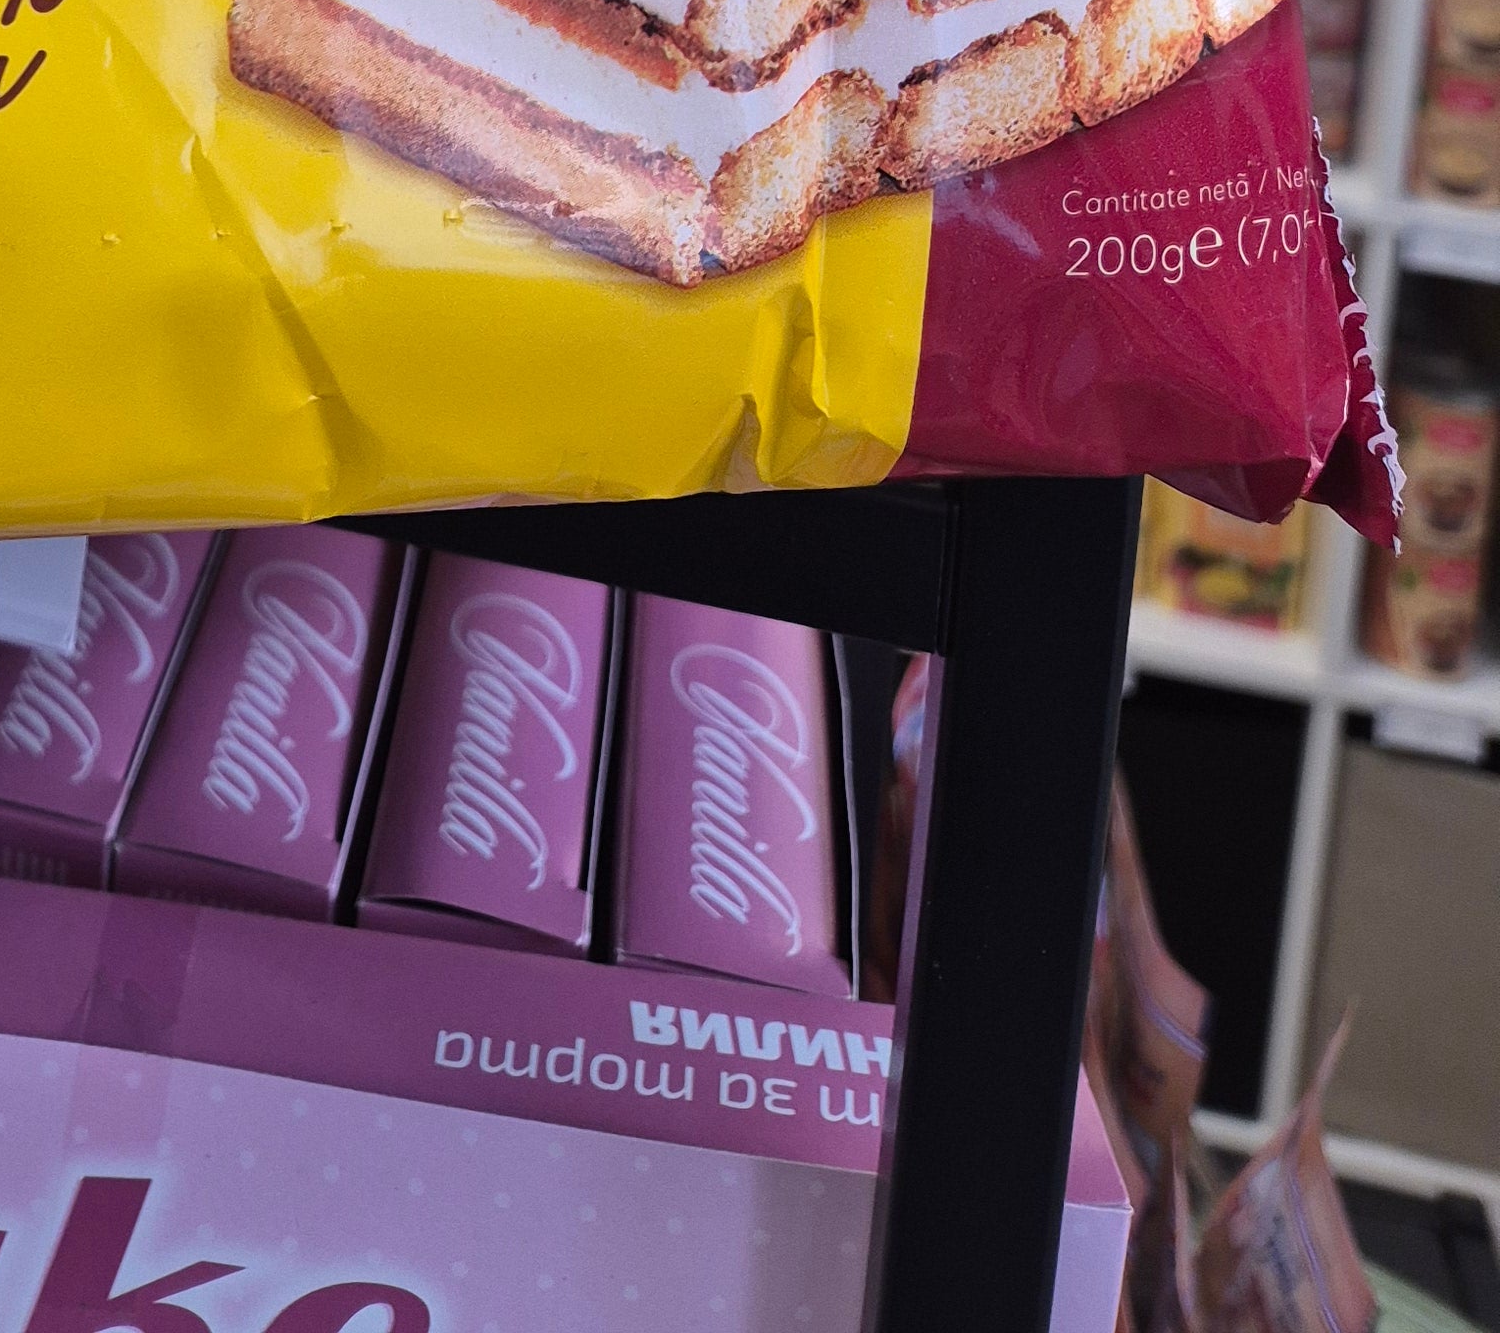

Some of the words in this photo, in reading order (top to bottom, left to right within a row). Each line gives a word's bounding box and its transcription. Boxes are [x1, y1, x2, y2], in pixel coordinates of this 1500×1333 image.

[1062, 184, 1190, 215] Cantitate
[203, 559, 368, 842] Vanilla
[439, 592, 583, 892] Vanilla
[670, 644, 818, 958] Vanilla
[434, 1030, 694, 1101] торта
[719, 1071, 798, 1116] за
